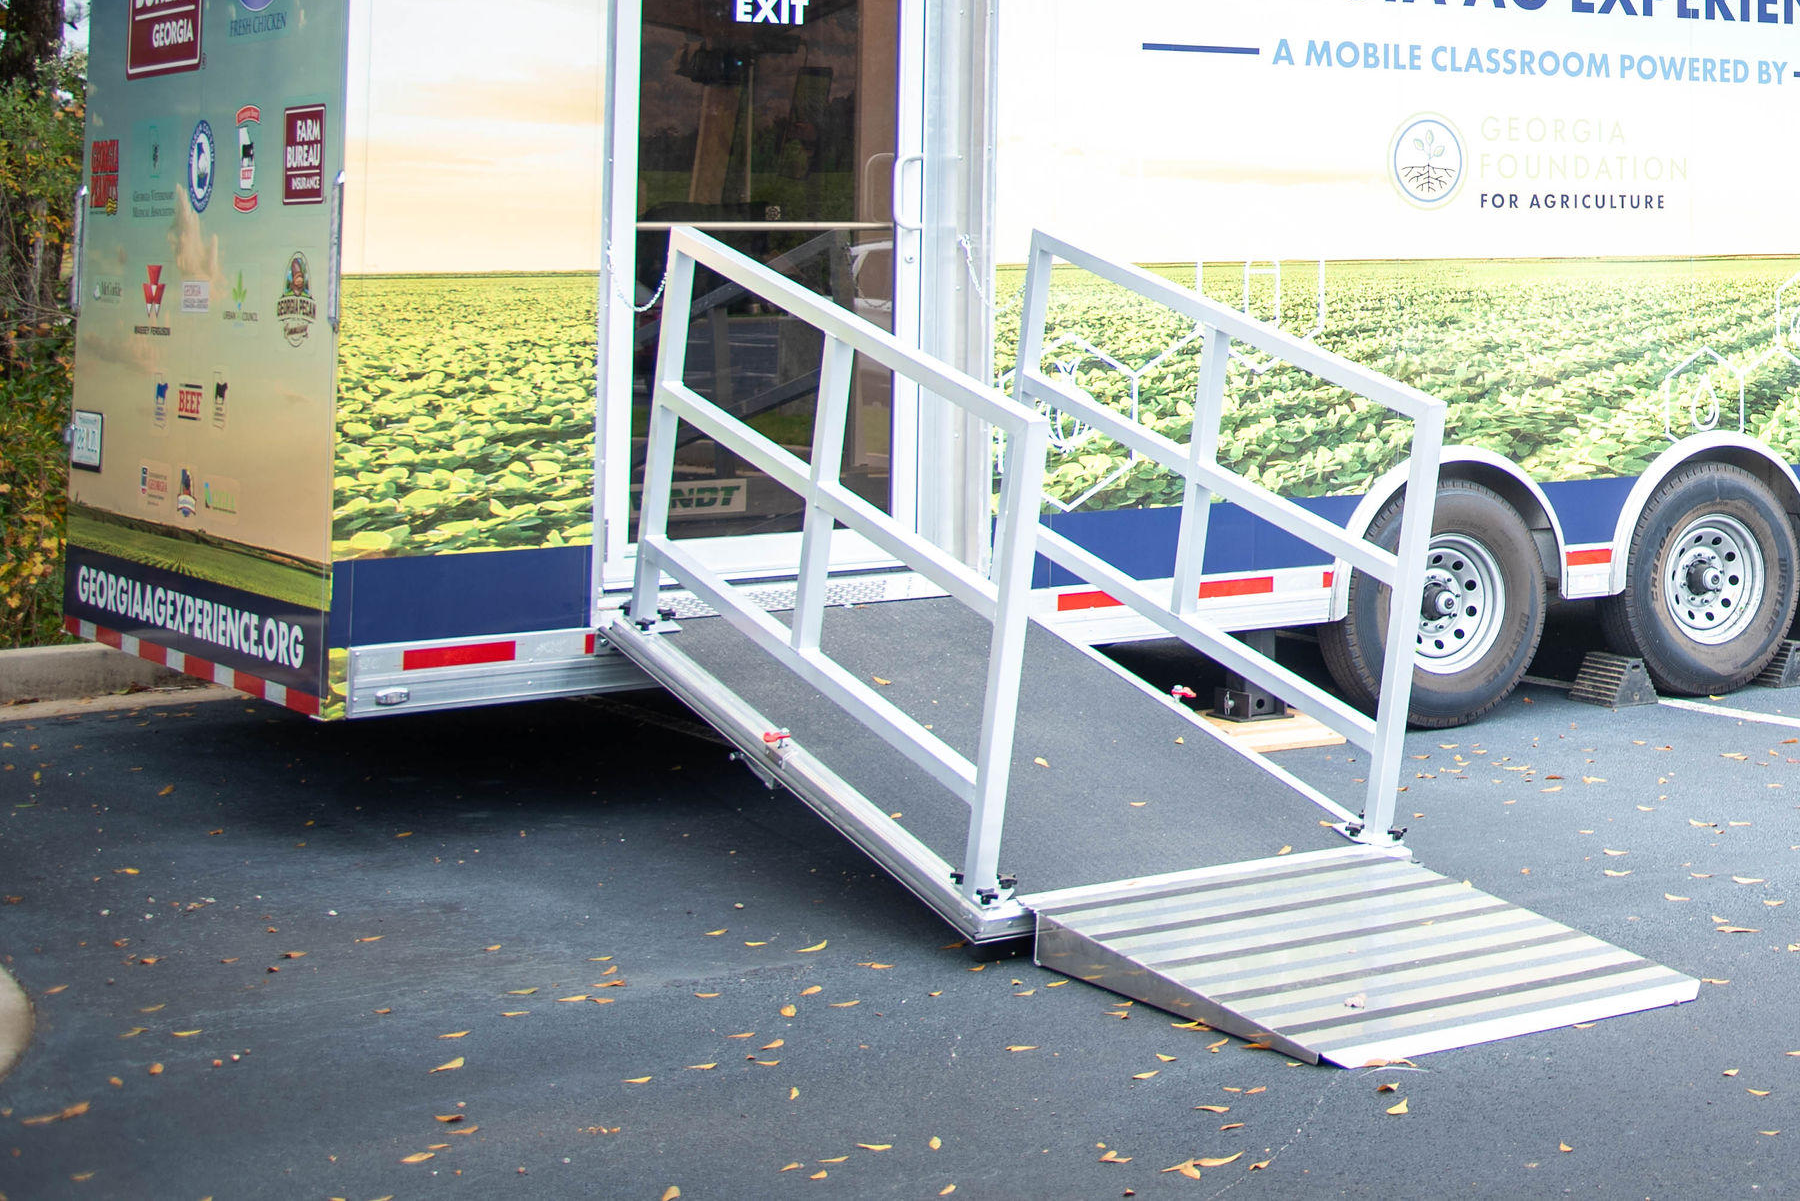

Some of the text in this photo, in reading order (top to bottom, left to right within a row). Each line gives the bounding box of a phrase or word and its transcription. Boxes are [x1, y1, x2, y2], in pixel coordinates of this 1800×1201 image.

[152, 18, 194, 48] GEORGIA
[230, 11, 287, 38] FRESH CHICKEN
[1272, 39, 1787, 85] A MOBILE CLASSROOM POWERED BY
[296, 118, 320, 143] FARM
[1481, 115, 1625, 144] GEORGIA
[286, 143, 321, 169] BUREAU
[1480, 153, 1687, 181] FOUNDATION
[291, 176, 320, 191] INSURANCE
[1480, 193, 1665, 209] FOR AGRICULTURE
[178, 389, 203, 415] BEEF
[78, 565, 305, 669] GEORGIAAGEXPERIENCE.ORG
